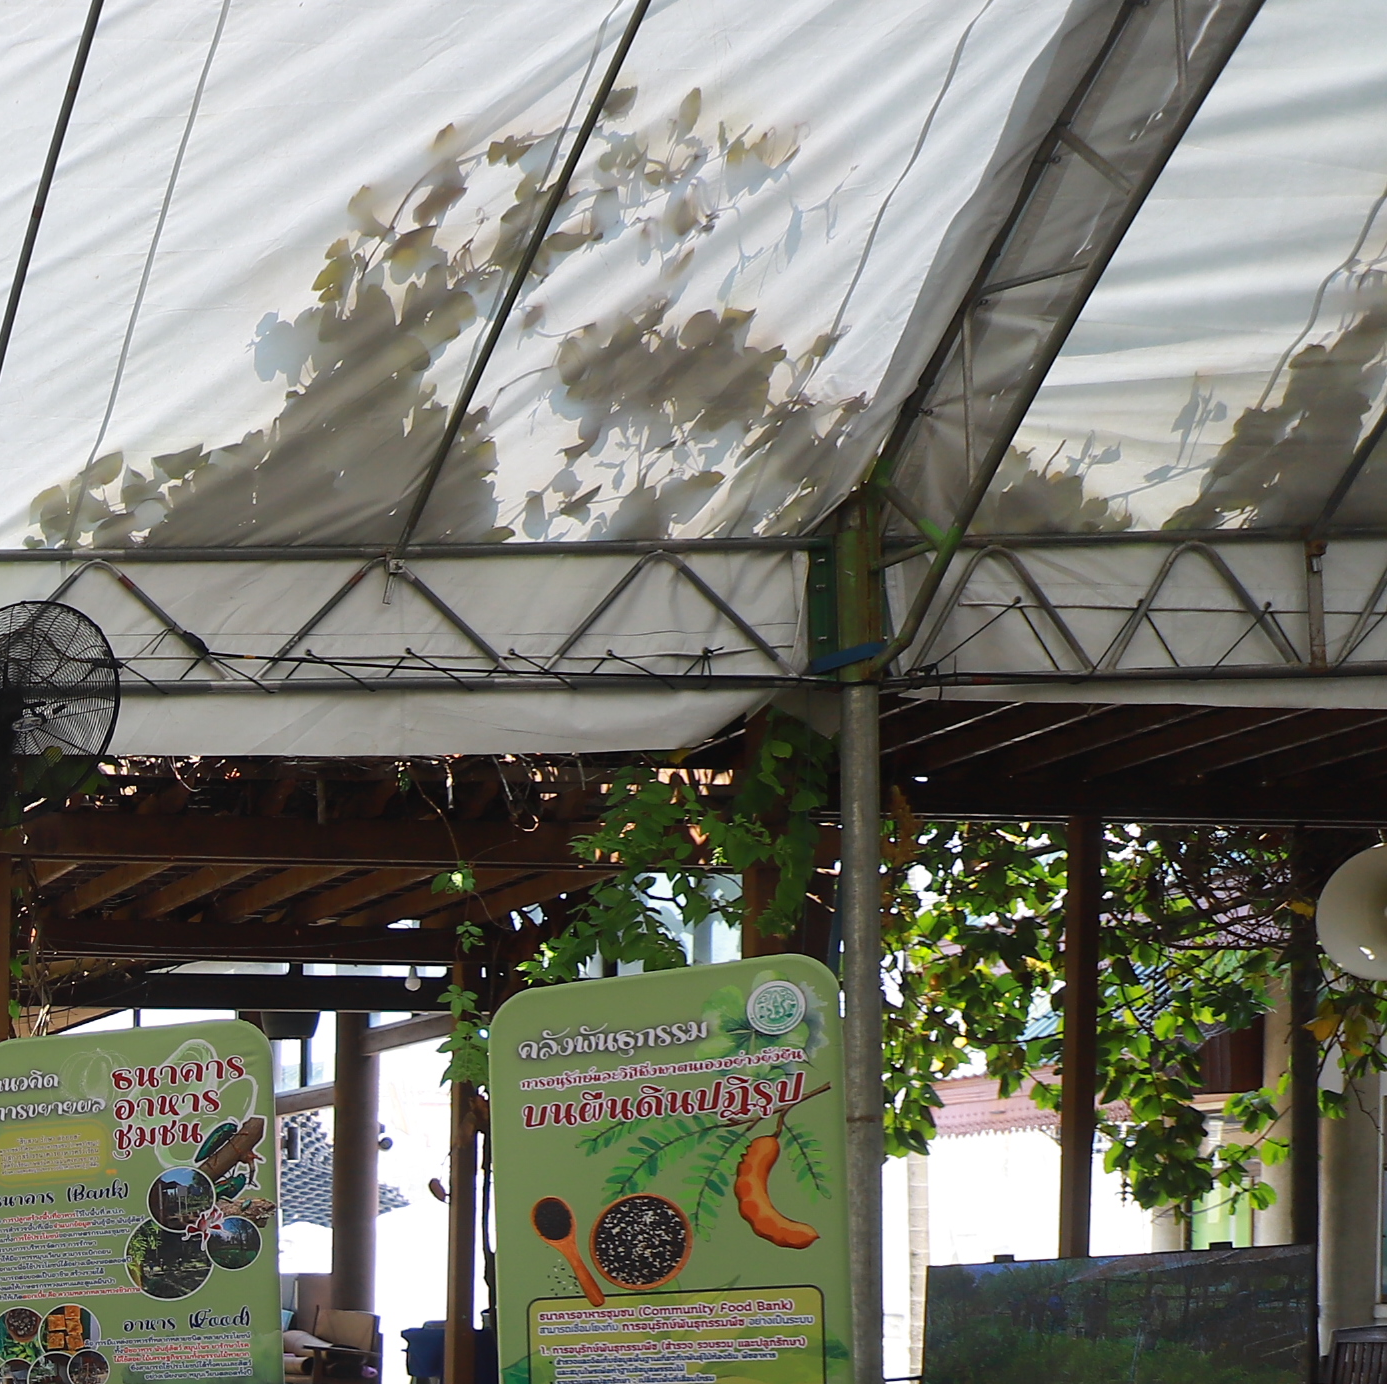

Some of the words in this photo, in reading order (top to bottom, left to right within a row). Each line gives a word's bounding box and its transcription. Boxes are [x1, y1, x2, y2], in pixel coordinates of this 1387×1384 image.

[517, 1020, 709, 1060] คลังพันธุกรรม
[110, 1055, 246, 1092] ธนาคาร
[113, 1088, 222, 1122] อาหาร
[522, 1070, 806, 1128] บนผืนดินปฏิรูป
[113, 1119, 204, 1161] ชุมชน
[67, 1179, 129, 1203] (Bank)
[122, 1317, 177, 1332] อาหาร
[539, 1308, 635, 1321] ธนาคารอาหารชุมชน
[638, 1303, 715, 1318] (Community
[720, 1301, 752, 1313] Food
[756, 1298, 793, 1312] Bank)
